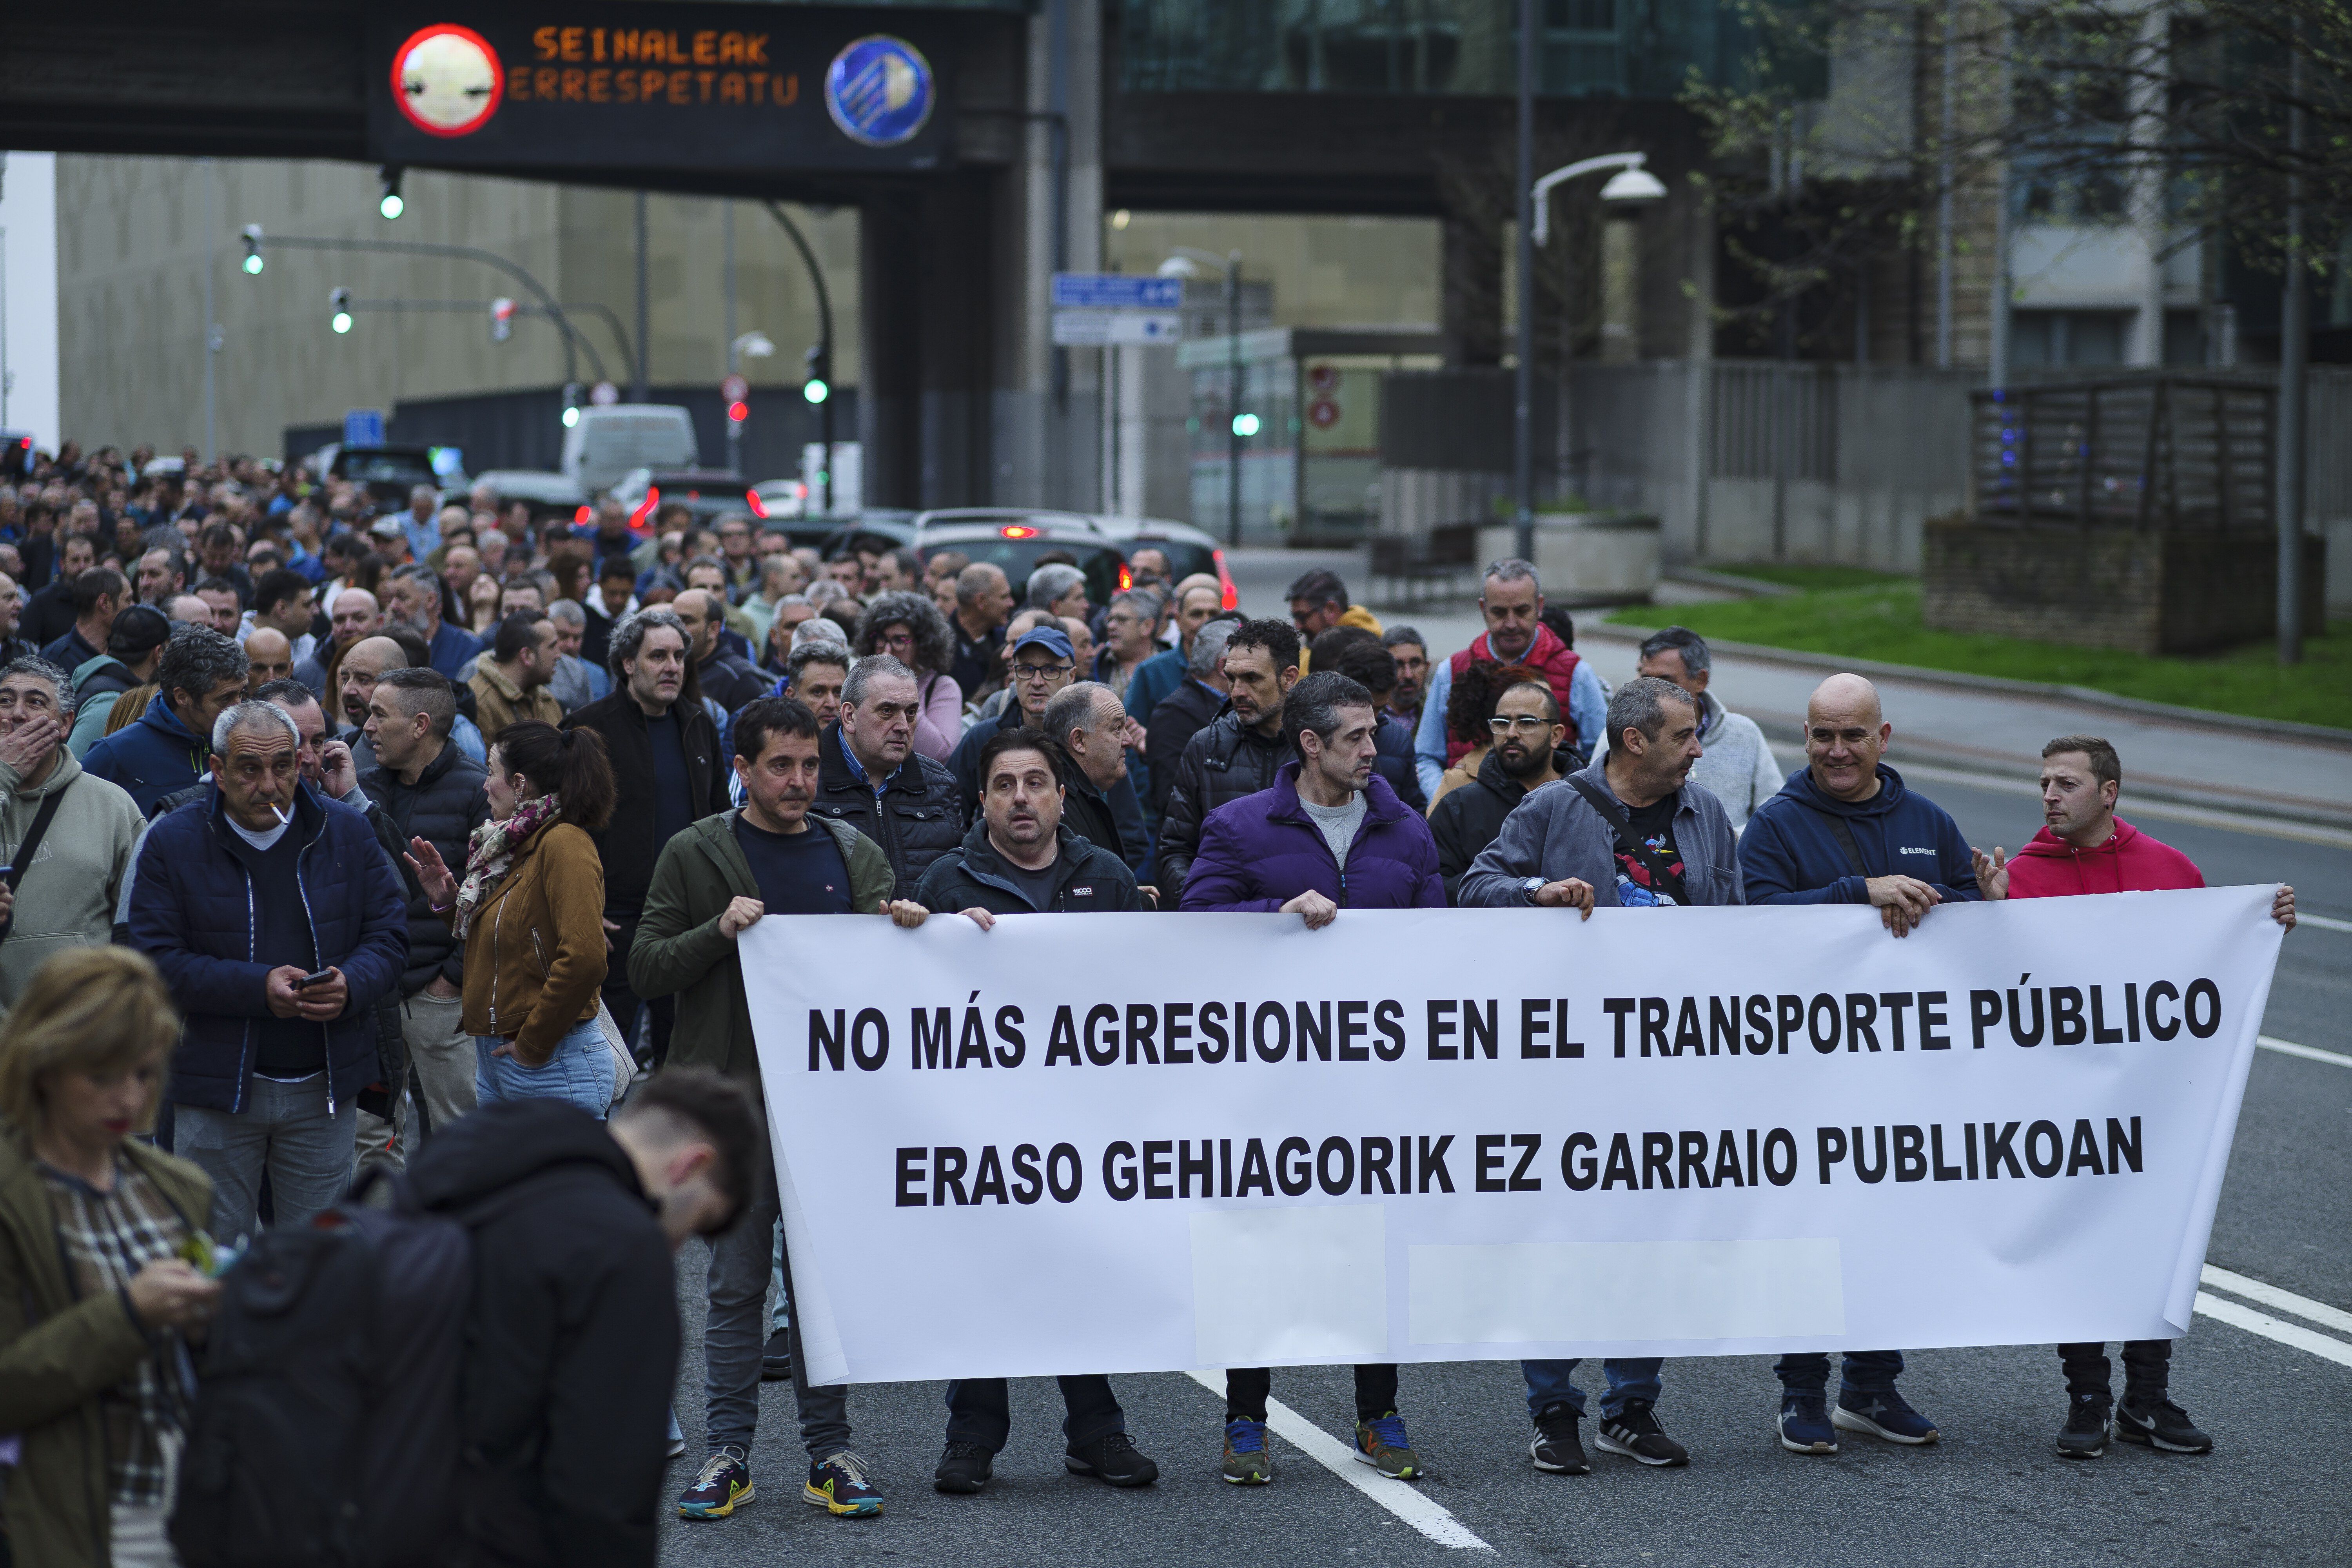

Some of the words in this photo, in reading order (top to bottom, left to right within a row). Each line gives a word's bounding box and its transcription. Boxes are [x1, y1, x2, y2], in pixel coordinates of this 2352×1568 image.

[533, 25, 769, 65] SEINALEAK
[508, 66, 799, 107] ERRESPETATU
[808, 1007, 889, 1072] NO
[911, 991, 1026, 1070] MÁS
[1044, 999, 1406, 1067] AGRESIONES
[1427, 999, 1498, 1060] EN
[1521, 998, 1584, 1059] EL
[1603, 991, 1951, 1058] TRANSPORTE
[1969, 973, 2221, 1049] PÚBLICO
[895, 1142, 1083, 1207] ERASO
[1102, 1135, 1456, 1201] GEHIAGORIK
[1475, 1133, 1541, 1192] EZ
[1561, 1127, 1797, 1191] GARRAIO
[1817, 1116, 2143, 1185] PUBLIKOAN
